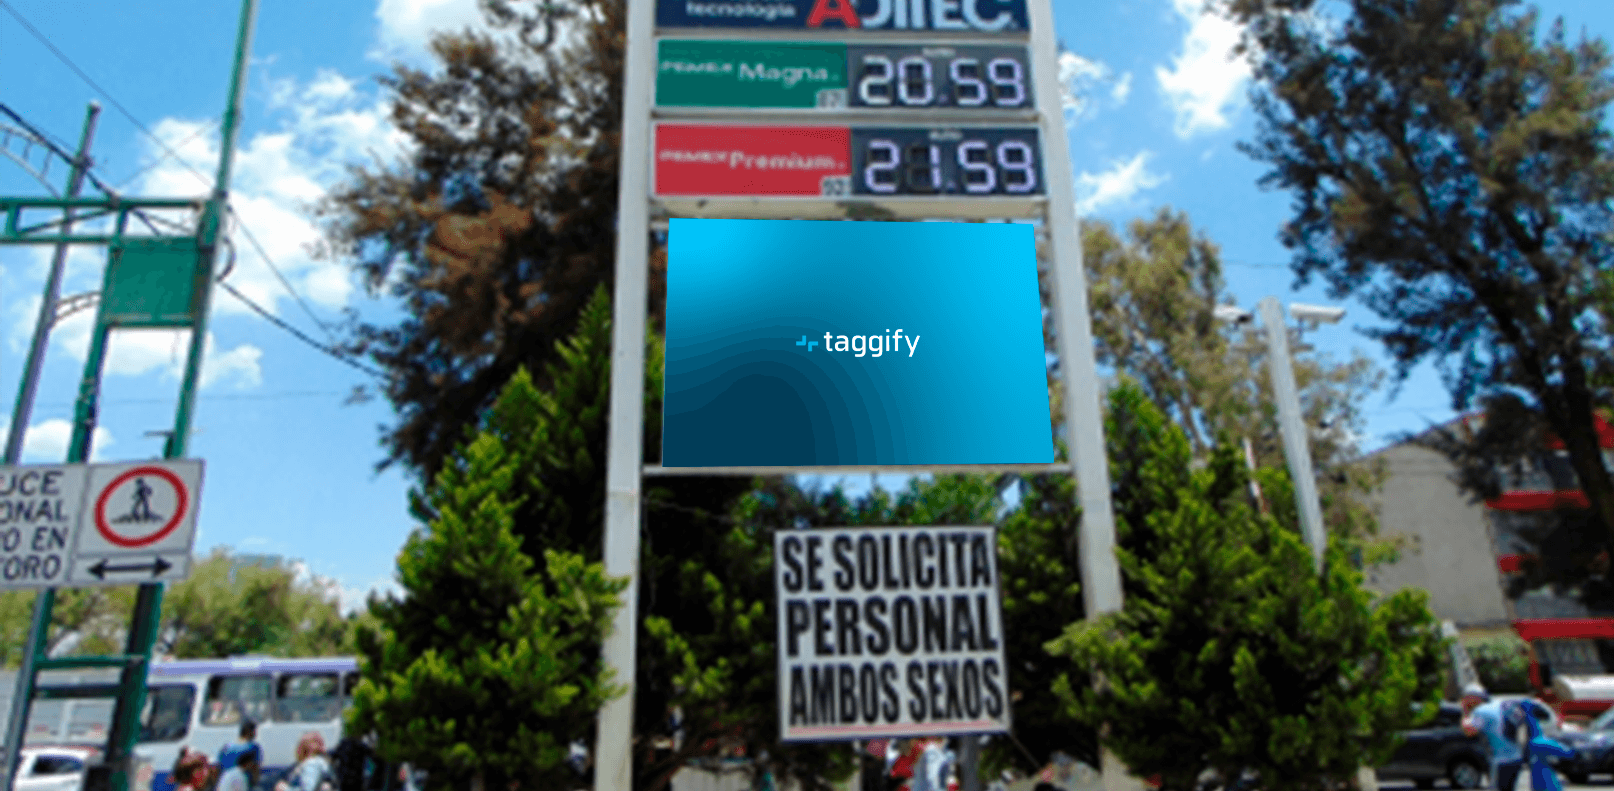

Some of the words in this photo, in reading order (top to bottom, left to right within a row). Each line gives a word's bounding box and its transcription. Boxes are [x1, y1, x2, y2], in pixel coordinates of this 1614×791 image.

[738, 62, 829, 88] Magna
[859, 55, 1026, 106] 20.59
[729, 151, 836, 170] Premium
[864, 140, 1036, 193] 21.59
[823, 329, 921, 358] taggify
[31, 525, 69, 551] EN
[782, 535, 824, 592] SE
[832, 532, 992, 591] SOLICITA
[785, 593, 998, 657] PERSONAL
[789, 662, 901, 726] AMBOS
[905, 657, 1003, 722] SEXOS
